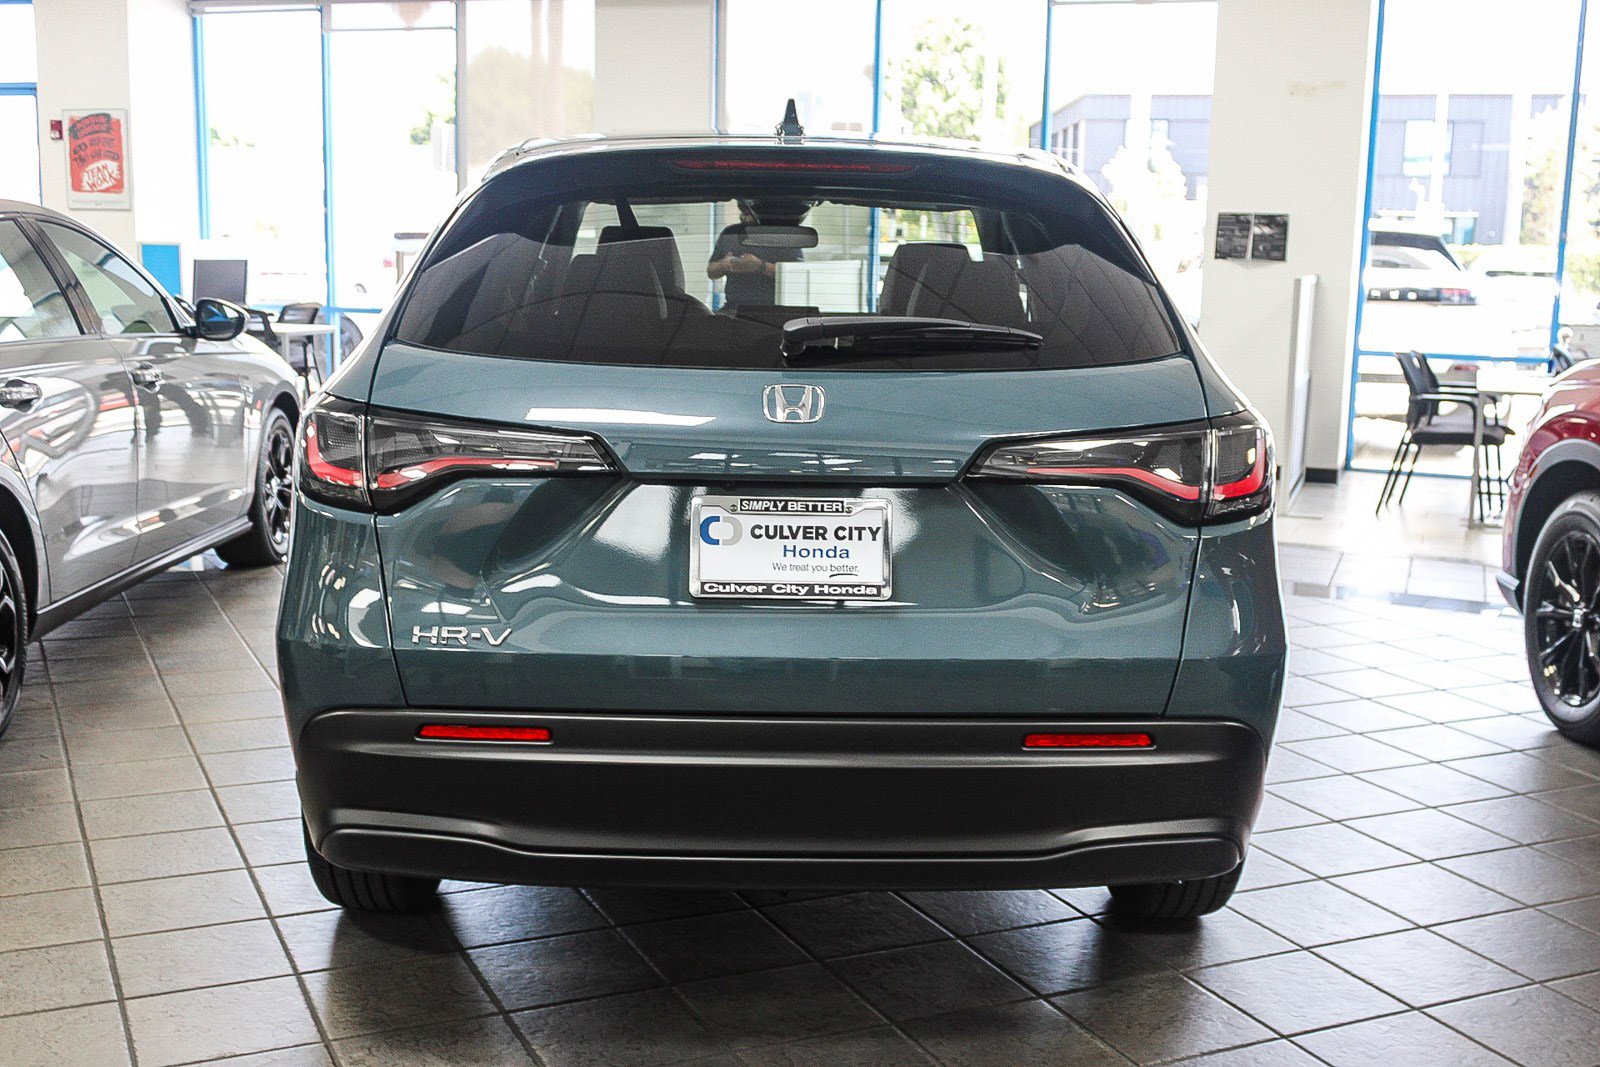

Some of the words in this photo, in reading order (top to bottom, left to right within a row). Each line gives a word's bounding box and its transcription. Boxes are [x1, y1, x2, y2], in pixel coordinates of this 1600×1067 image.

[741, 500, 786, 512] SIMPLY
[787, 501, 843, 513] BETTER
[750, 524, 828, 541] CULVER
[833, 526, 882, 542] CITY
[783, 544, 850, 559] Honda
[772, 563, 788, 572] We
[789, 563, 810, 572] treat
[811, 565, 829, 574] you
[703, 582, 768, 594] Culver
[771, 583, 810, 596] City
[813, 583, 878, 596] Honda
[411, 625, 513, 647] HR-V
